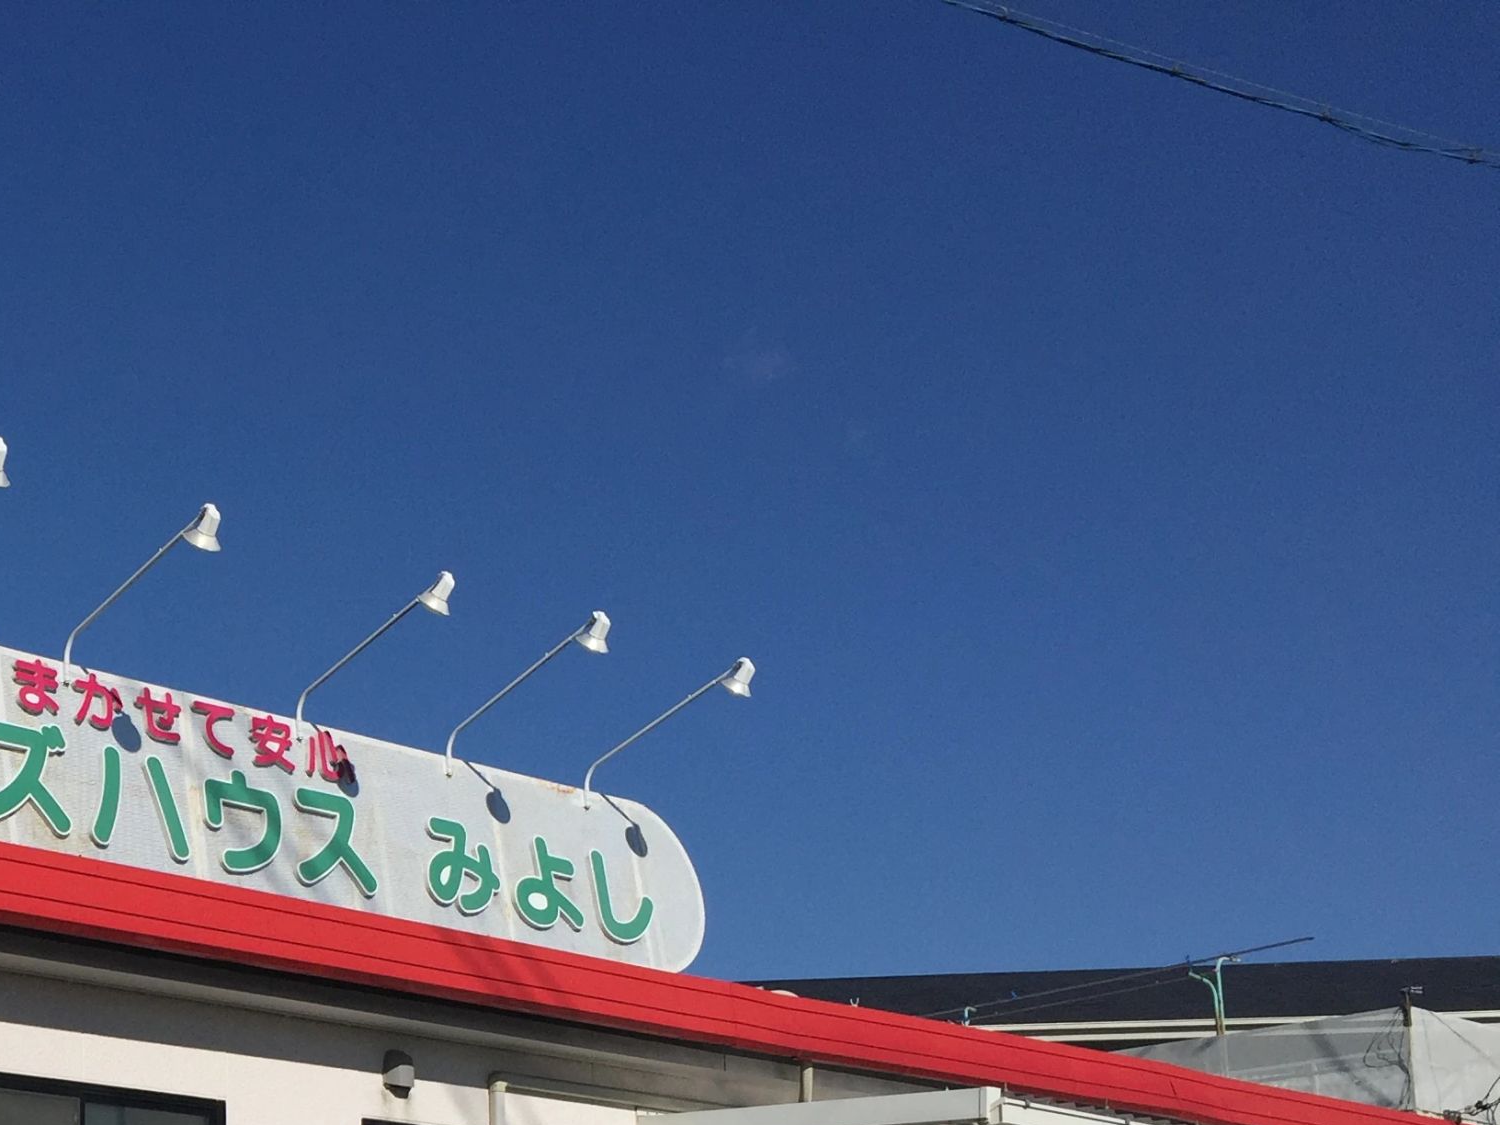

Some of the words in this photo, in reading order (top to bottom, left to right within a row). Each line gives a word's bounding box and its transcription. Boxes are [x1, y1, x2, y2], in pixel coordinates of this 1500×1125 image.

[13, 659, 356, 784] まかせて安心
[426, 817, 654, 944] みよし
